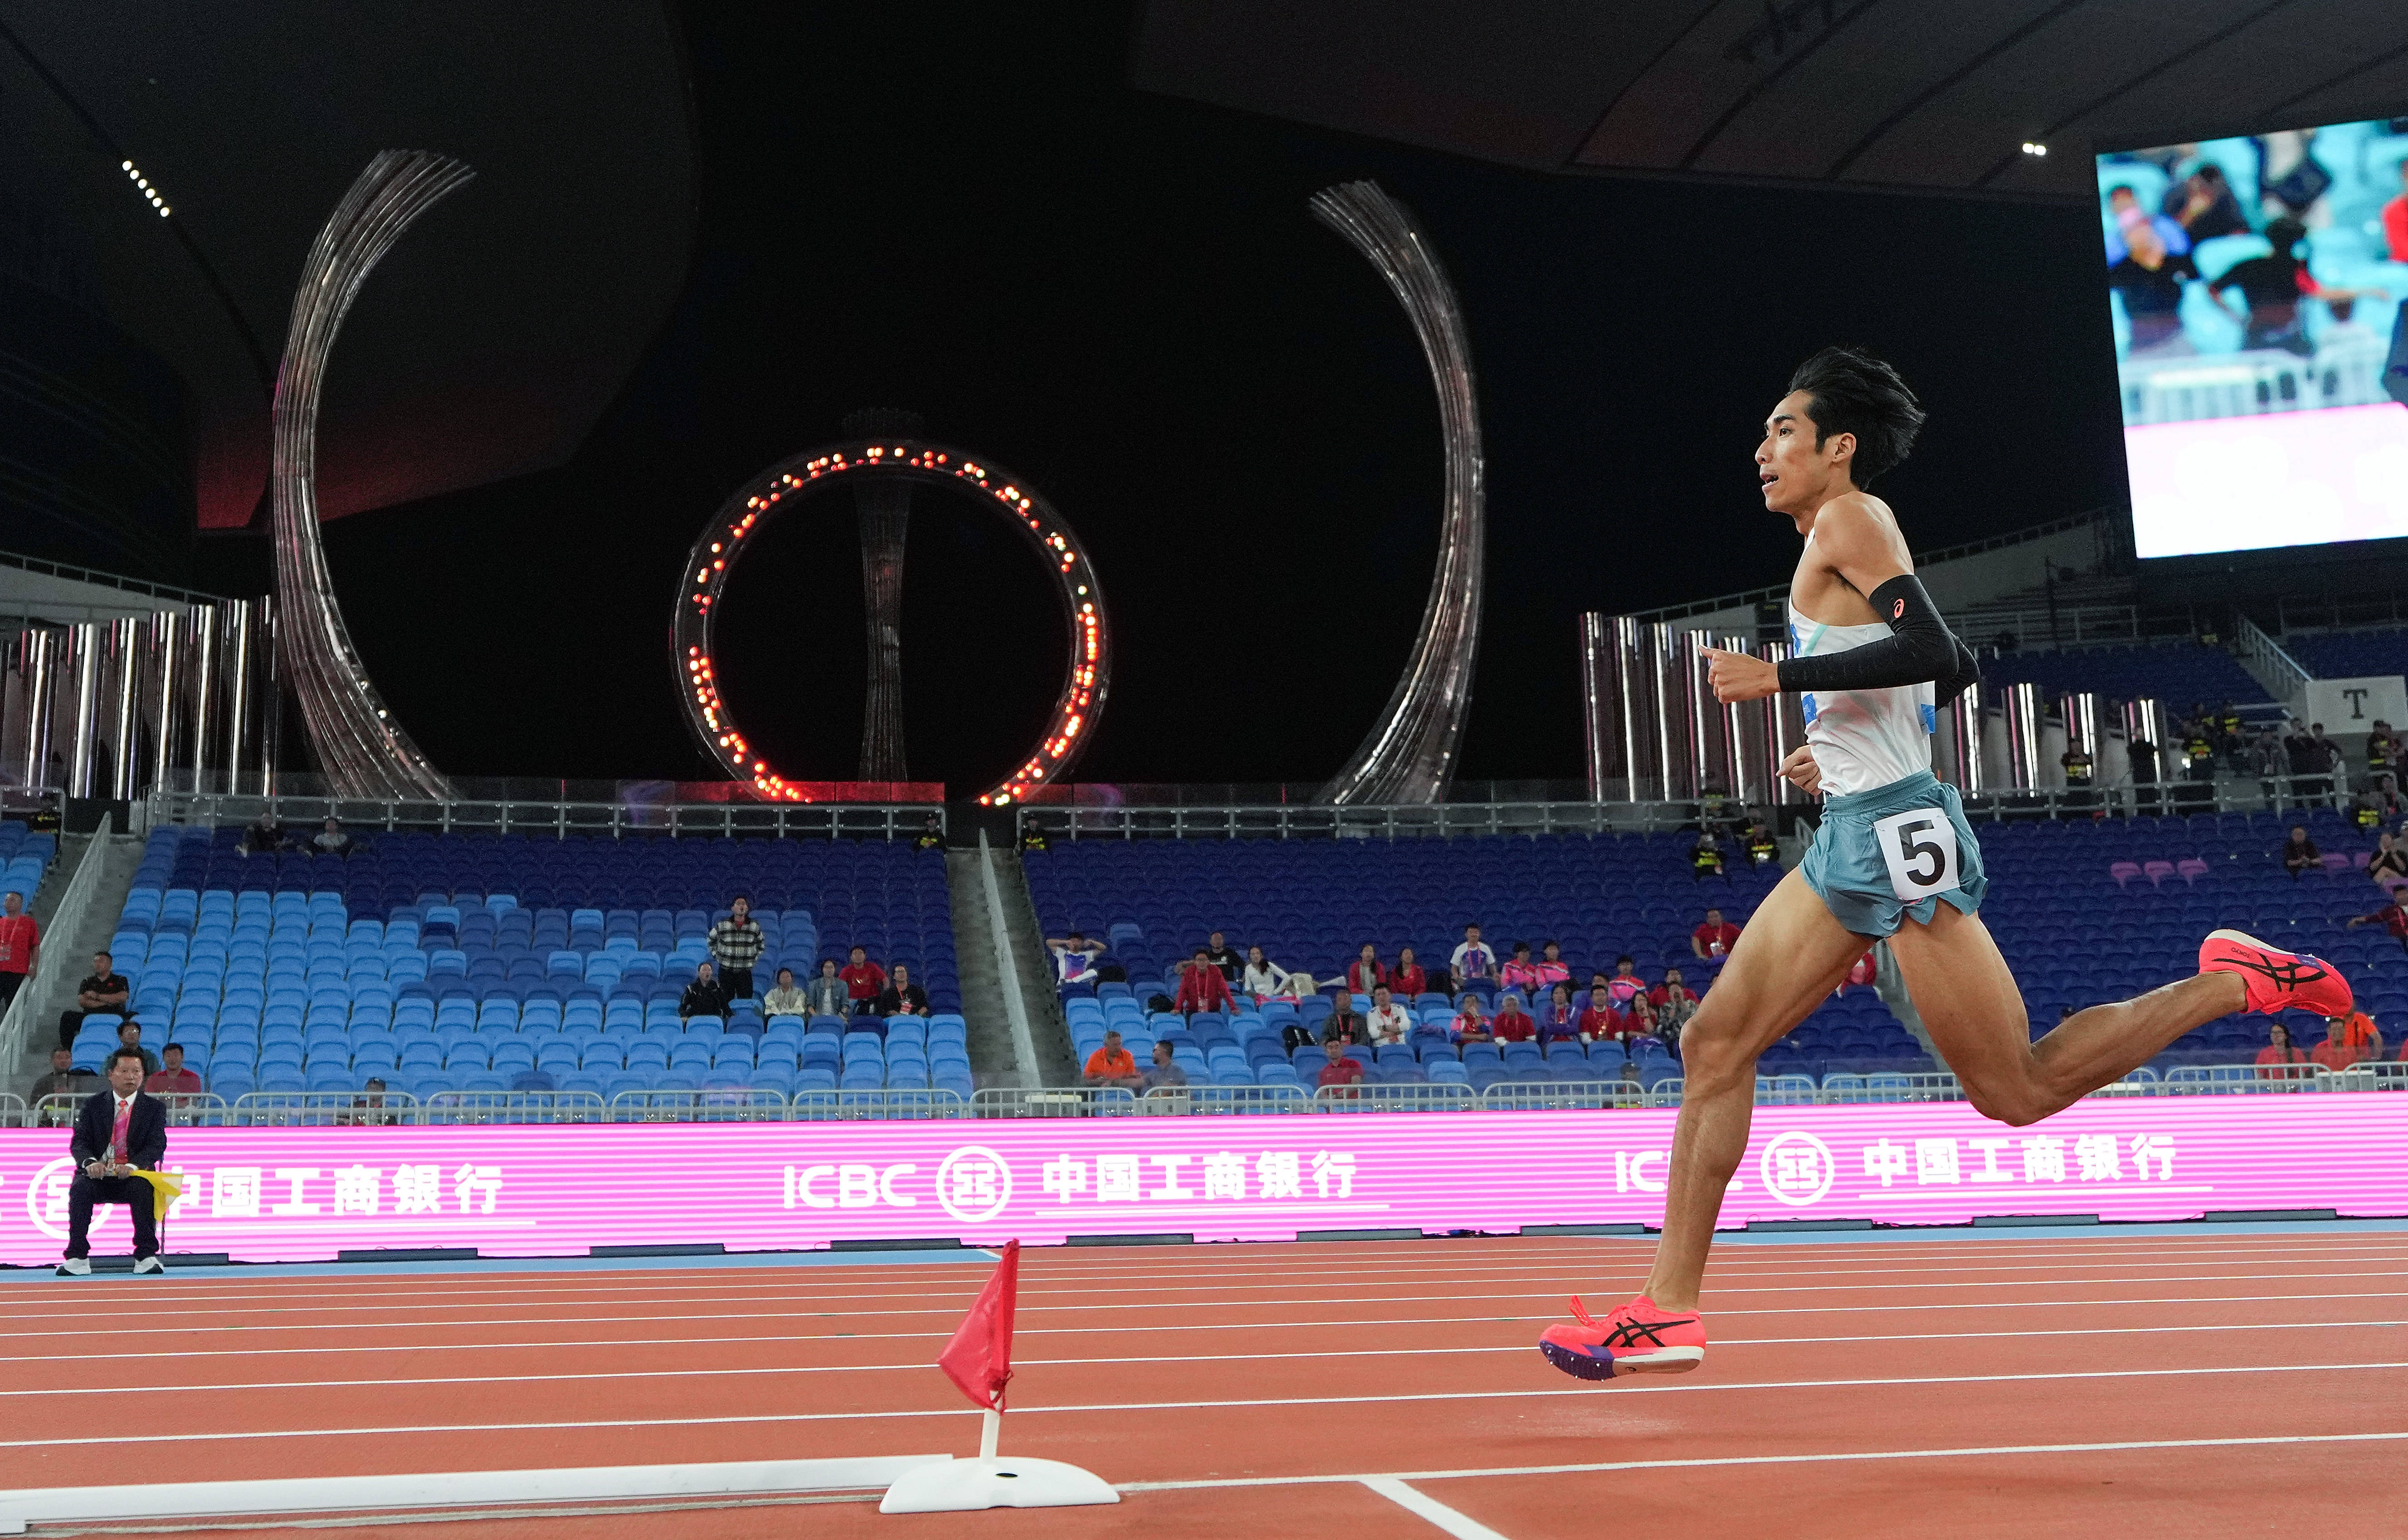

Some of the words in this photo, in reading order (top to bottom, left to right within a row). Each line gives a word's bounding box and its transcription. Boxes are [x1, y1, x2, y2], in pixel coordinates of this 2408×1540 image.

[2343, 689, 2368, 719] T
[1898, 819, 1945, 886] 5
[1043, 1150, 1357, 1203] 中国工商银行
[1614, 1150, 1743, 1192] IC
[1862, 1132, 2176, 1186] 中国工商银行
[783, 1164, 917, 1209] ICBC
